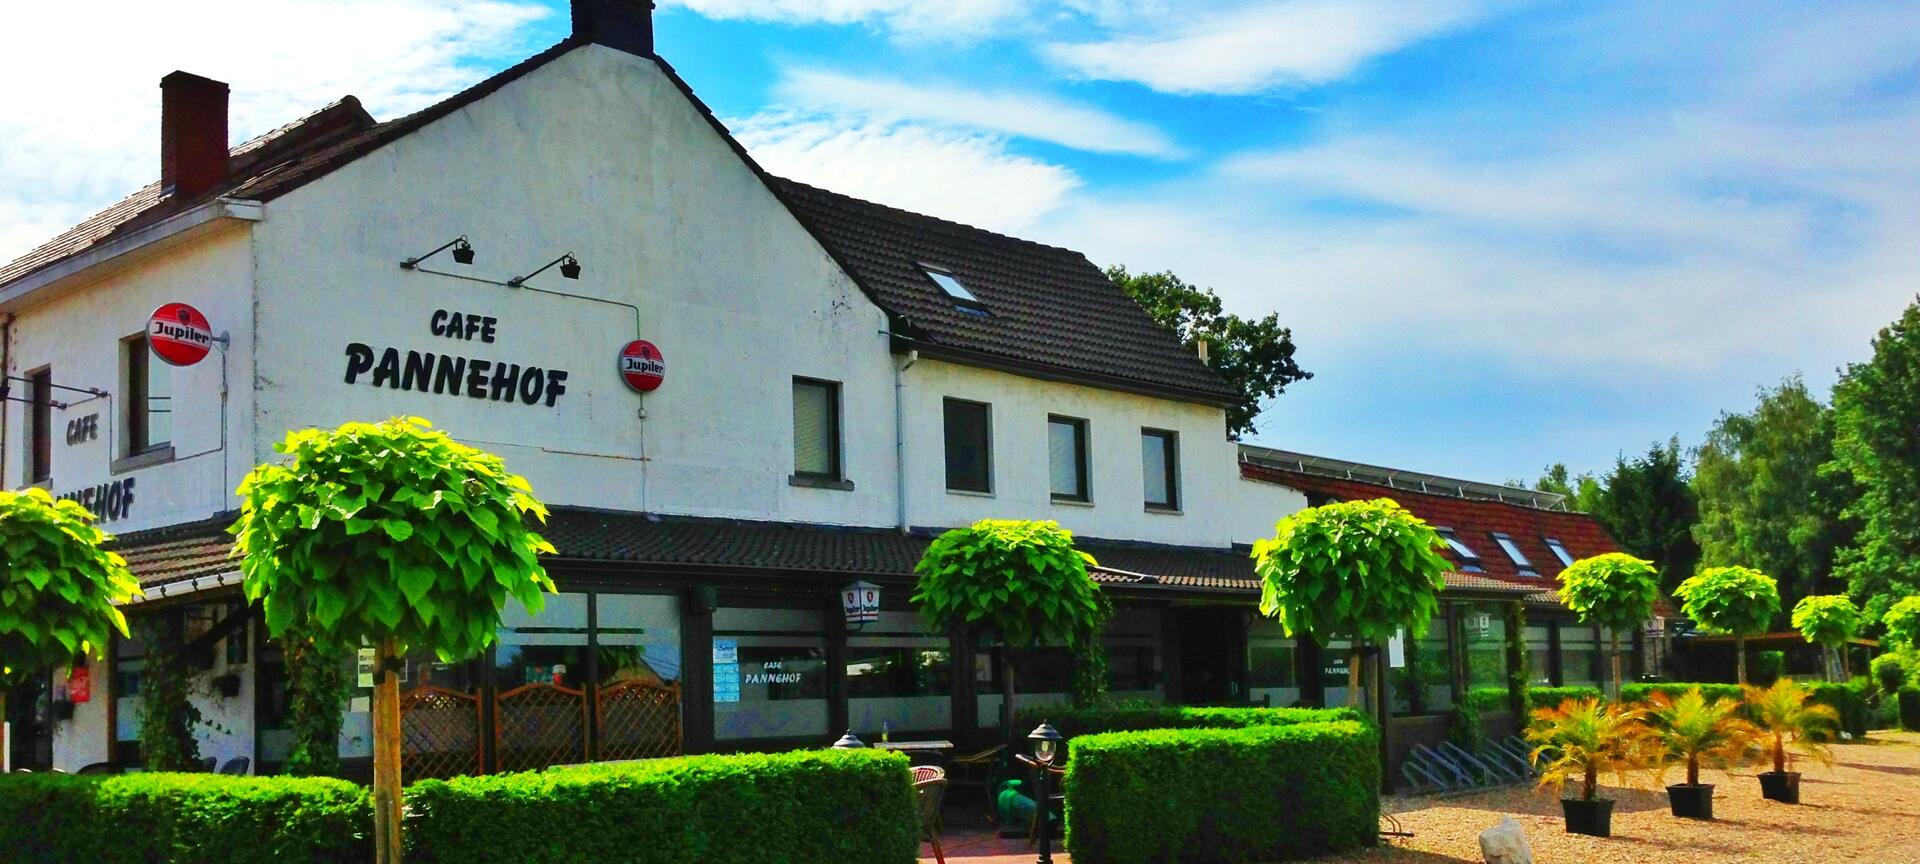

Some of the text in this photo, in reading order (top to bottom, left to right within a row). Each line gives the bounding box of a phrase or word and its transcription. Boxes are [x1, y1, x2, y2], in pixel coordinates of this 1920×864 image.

[153, 321, 209, 344] Jupiler
[431, 309, 498, 343] CAFE
[344, 342, 569, 408] PANNEHOF
[625, 358, 664, 374] Jupiler
[66, 413, 99, 447] CAFE
[744, 672, 802, 684] PANNEHOF
